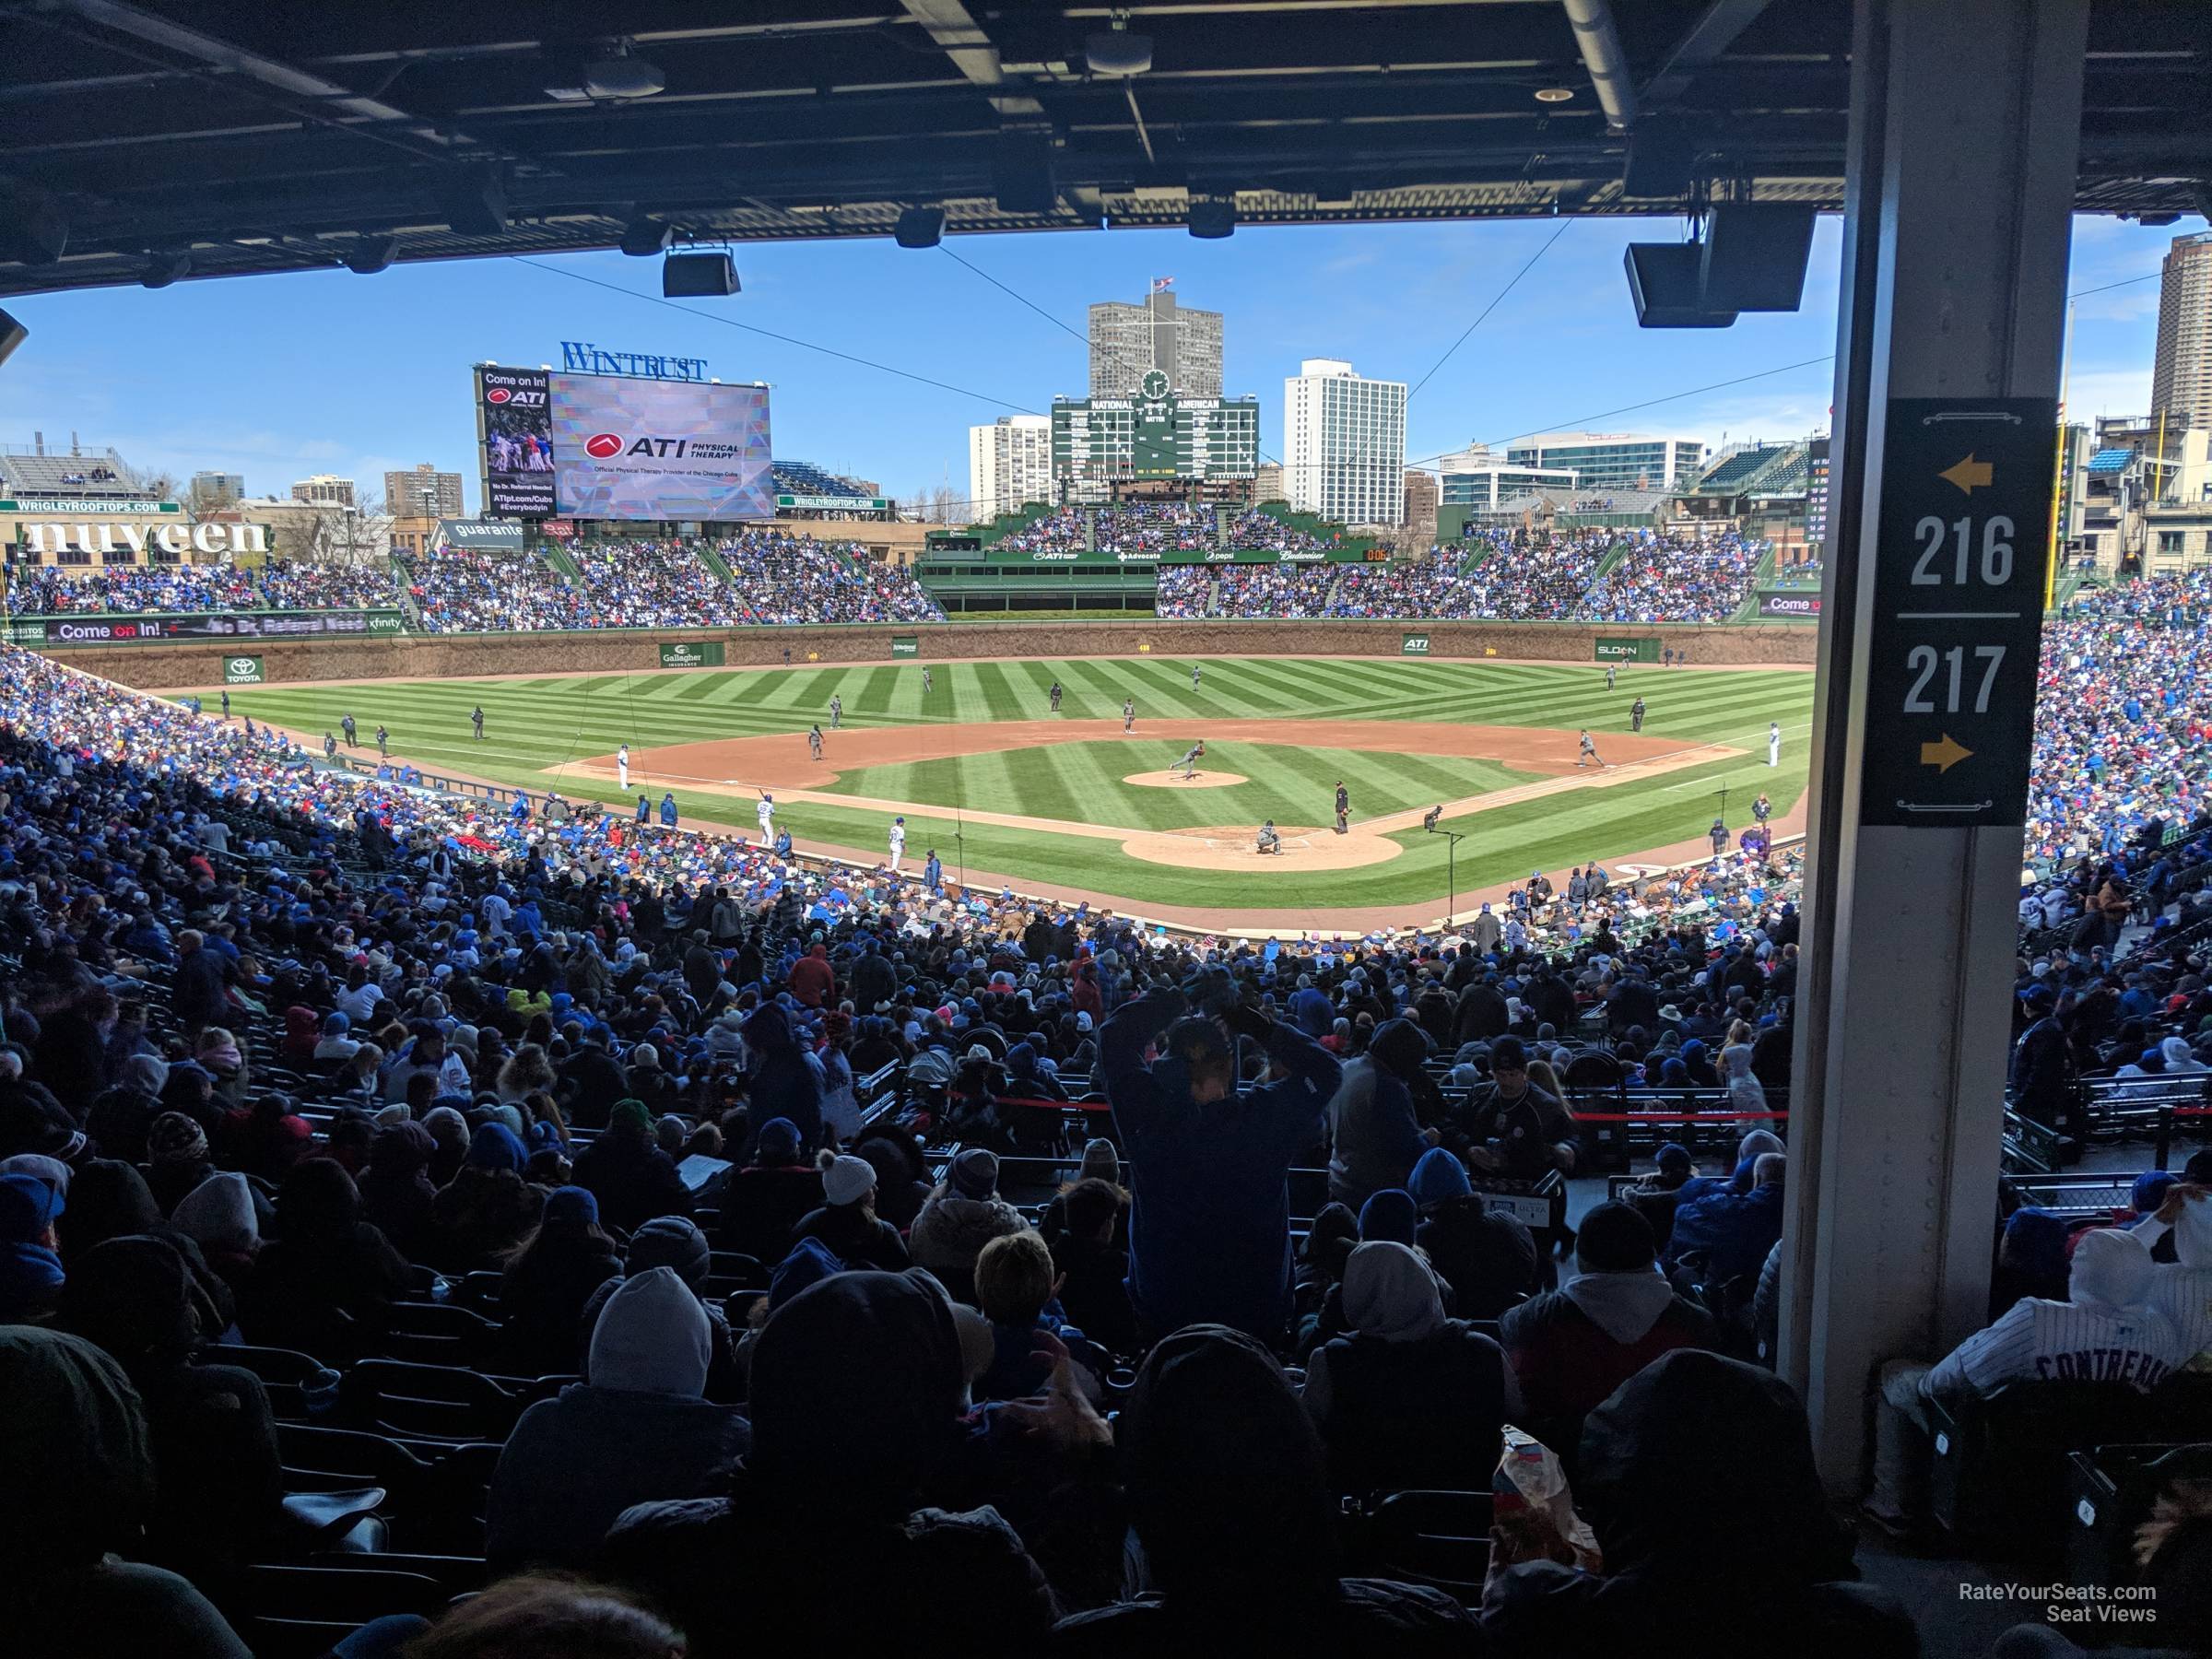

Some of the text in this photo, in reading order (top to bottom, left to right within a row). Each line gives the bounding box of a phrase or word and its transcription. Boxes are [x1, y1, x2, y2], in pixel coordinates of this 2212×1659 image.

[559, 341, 708, 381] WINTRUST
[486, 373, 546, 387] Come on In!
[511, 391, 547, 404] ATI
[1091, 401, 1135, 409] NATIONAL
[1177, 400, 1220, 409] AMERICAN
[627, 438, 687, 458] ATI
[692, 443, 738, 453] PHYSICAL
[690, 451, 734, 459] THERAPY
[494, 495, 553, 503] ATIpt.com/Cubs
[794, 498, 873, 508] WRIGLEYROOFTOPS.COM
[18, 500, 160, 512] WRIGLEYROOFTOPS.COM
[26, 521, 270, 554] nuveen
[1279, 550, 1325, 560] Budweiser
[1910, 514, 2016, 586] 216
[1215, 552, 1234, 560] pepsi
[1368, 551, 1386, 561] 0:06
[1771, 597, 1810, 609] Come
[369, 617, 401, 629] xfinity
[59, 622, 160, 639] Come on In!
[1405, 640, 1429, 648] ATI
[663, 654, 702, 663] Gallagher
[227, 675, 261, 683] TOYOTA
[1902, 645, 2006, 713] 217
